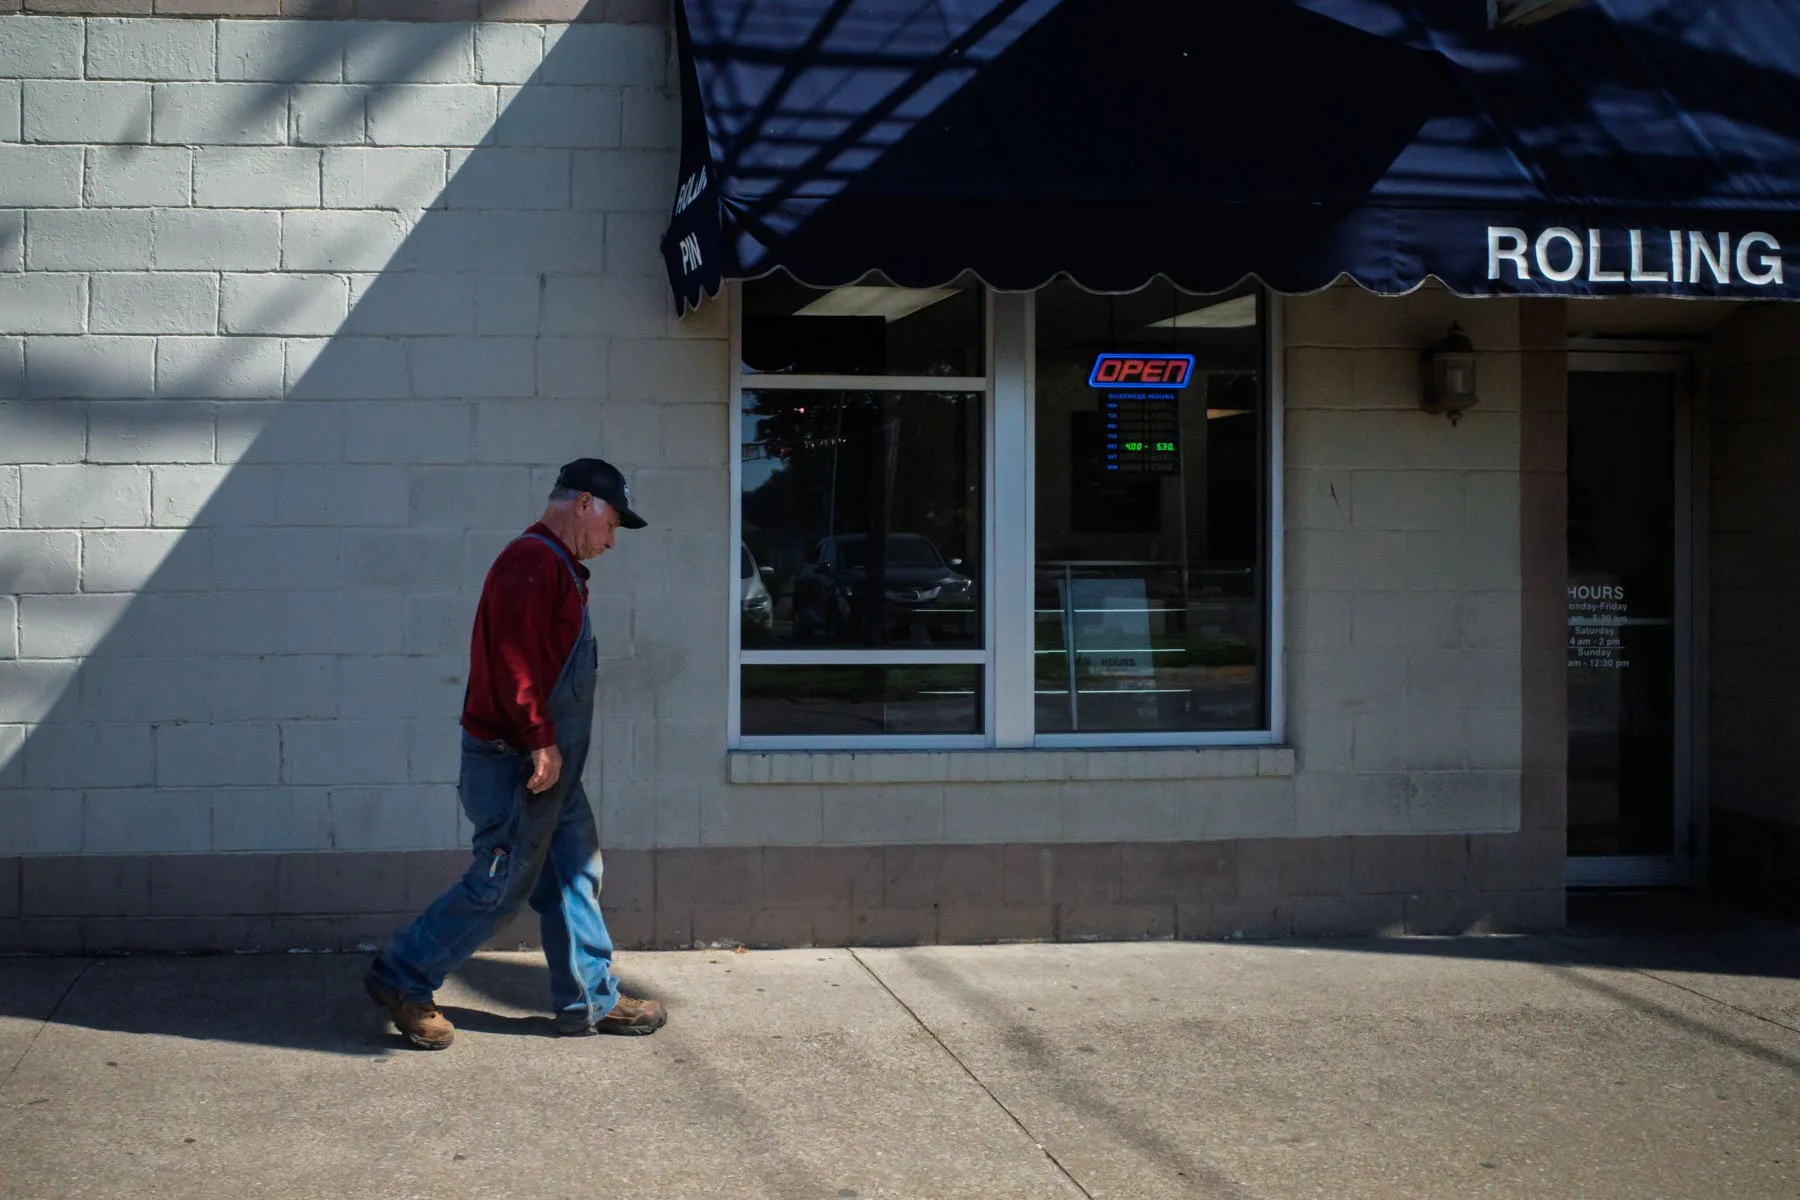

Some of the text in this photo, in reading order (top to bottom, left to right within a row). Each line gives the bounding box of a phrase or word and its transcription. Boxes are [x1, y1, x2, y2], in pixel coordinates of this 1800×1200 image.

[680, 231, 703, 276] PIN
[1488, 226, 1784, 285] ROLLING
[1096, 359, 1188, 382] OPEN
[1568, 586, 1625, 600] HOURS
[1568, 601, 1628, 612] onday-Friday
[1574, 626, 1615, 636] Saturday
[1599, 637, 1604, 645] 2
[1606, 638, 1621, 647] pm
[1577, 648, 1611, 658] Sunday
[1590, 659, 1613, 667] 12:30
[1615, 660, 1630, 669] pm
